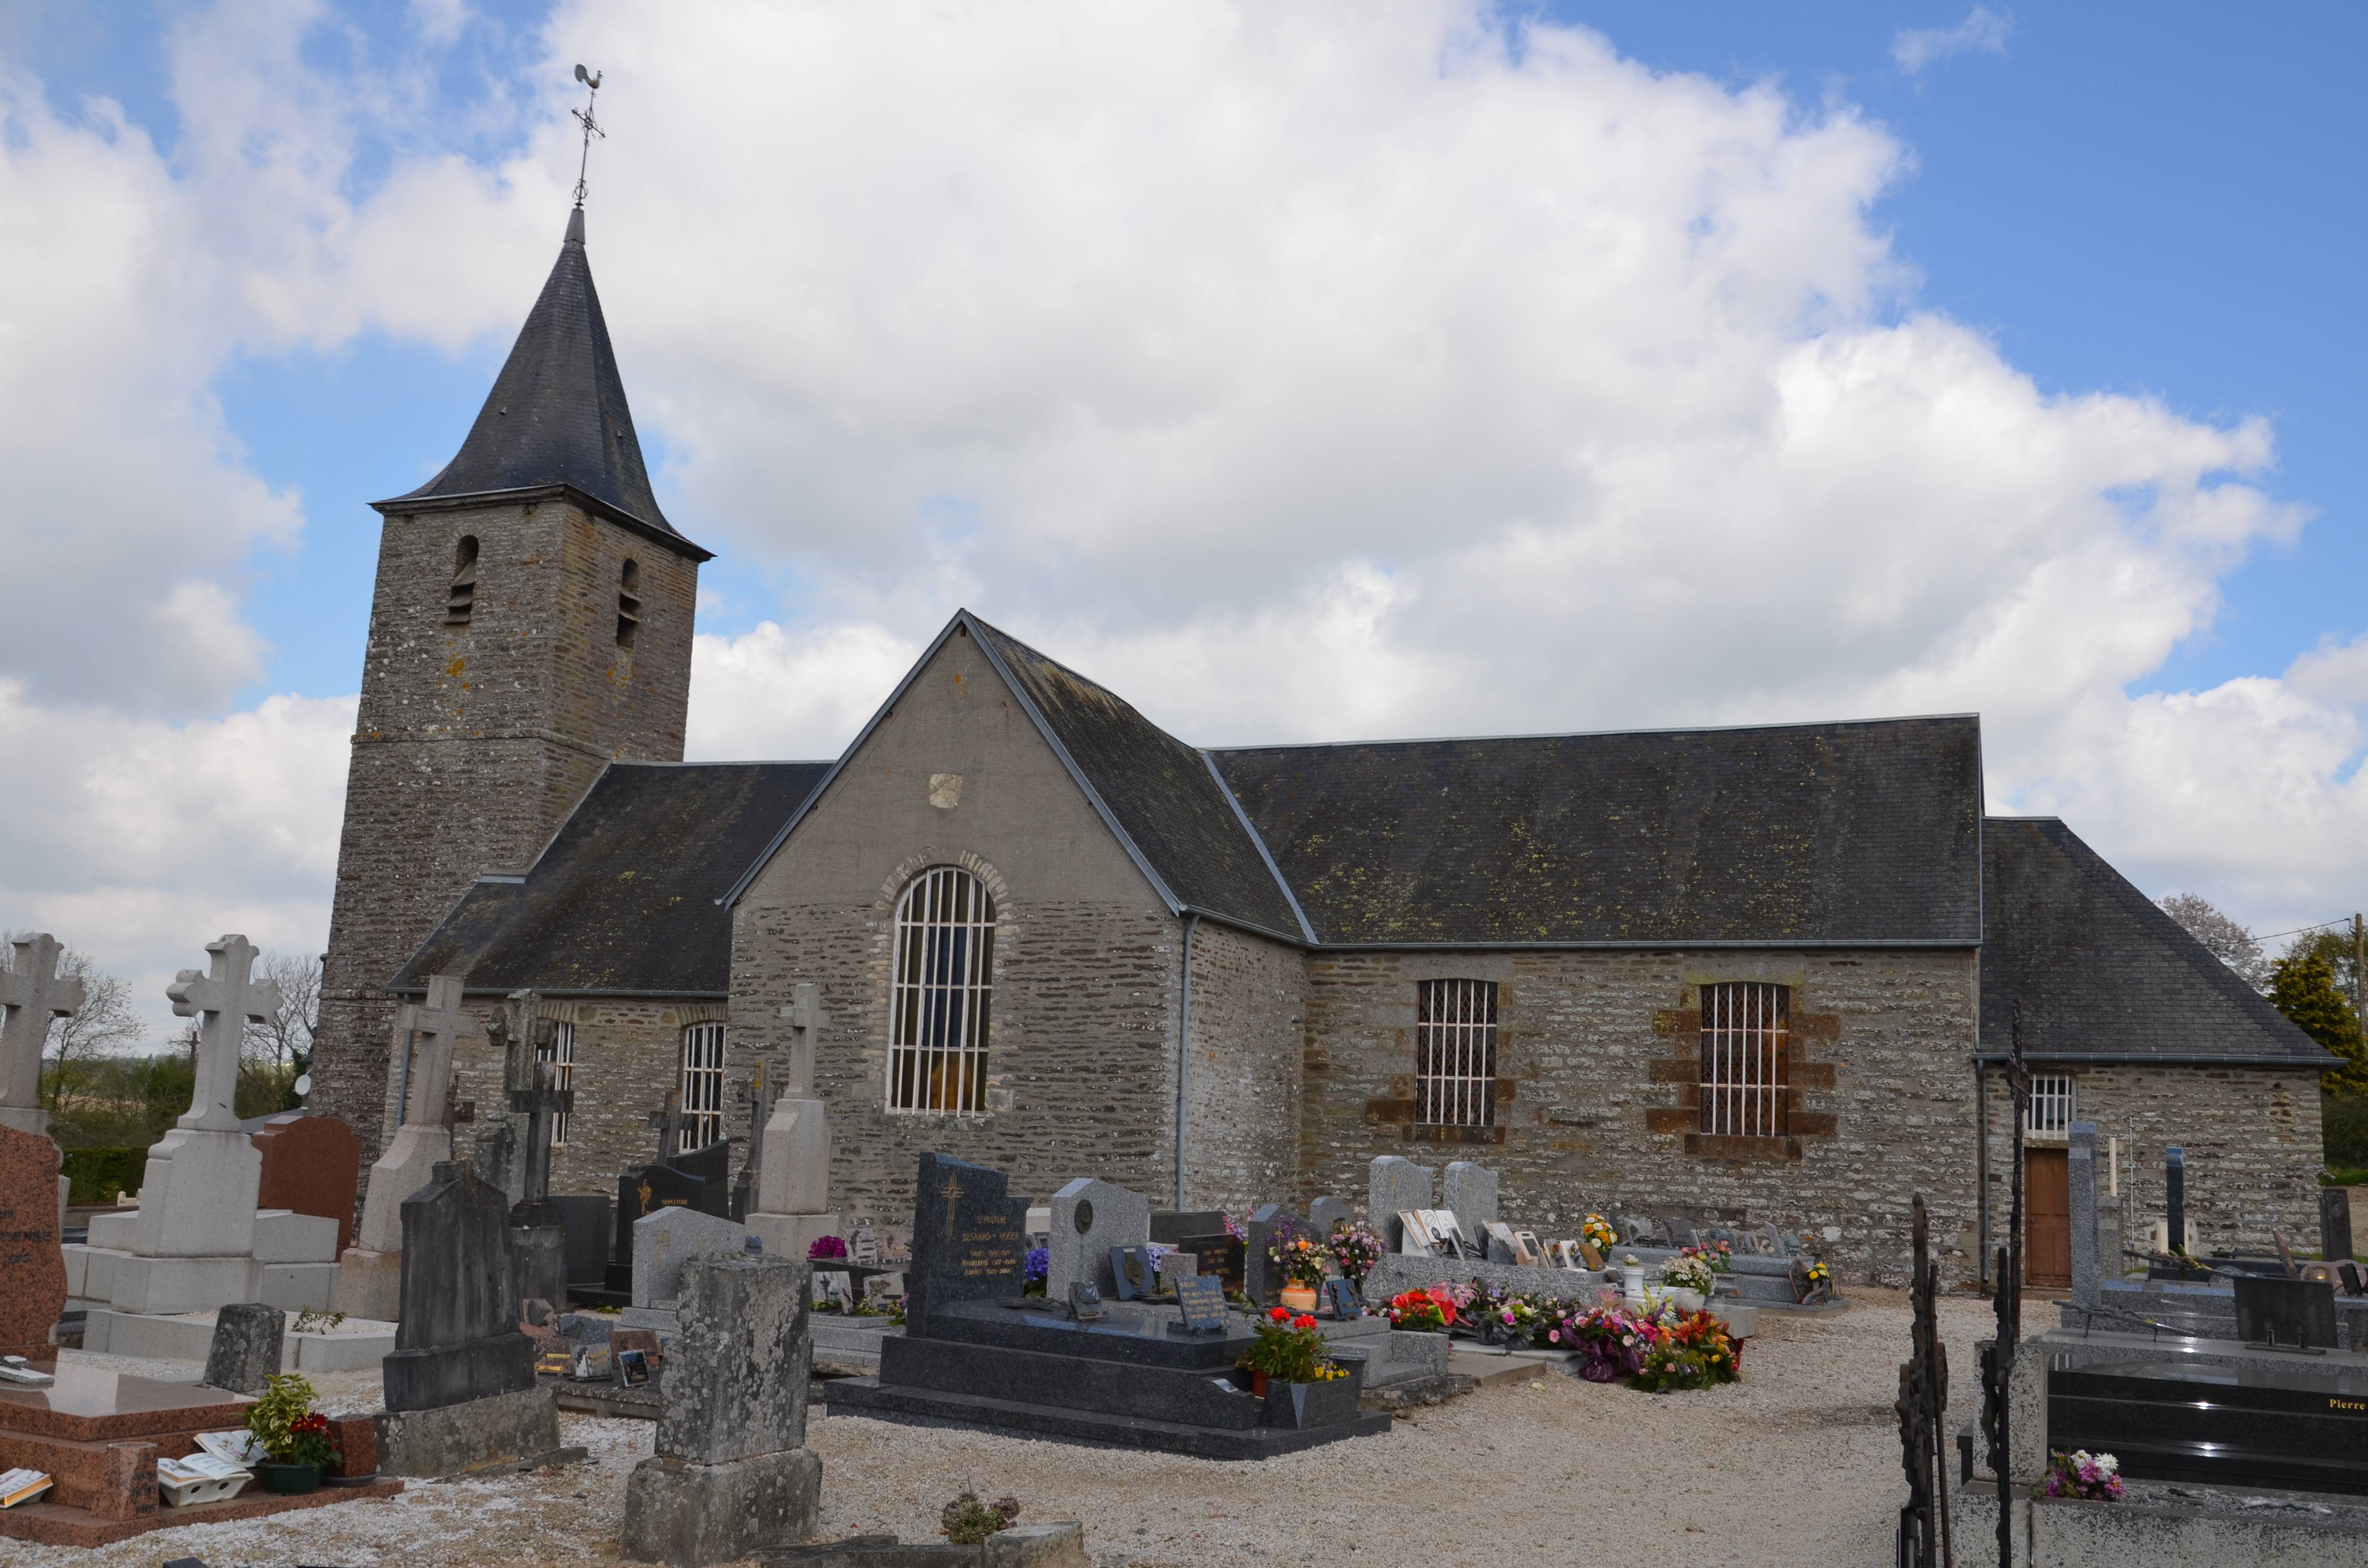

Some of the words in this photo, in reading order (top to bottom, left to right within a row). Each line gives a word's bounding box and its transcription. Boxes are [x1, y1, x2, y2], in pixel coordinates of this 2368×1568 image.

[962, 1233, 991, 1242] BESNARD
[999, 1232, 1019, 1240] ROGER
[2329, 1398, 2366, 1410] Pierre
